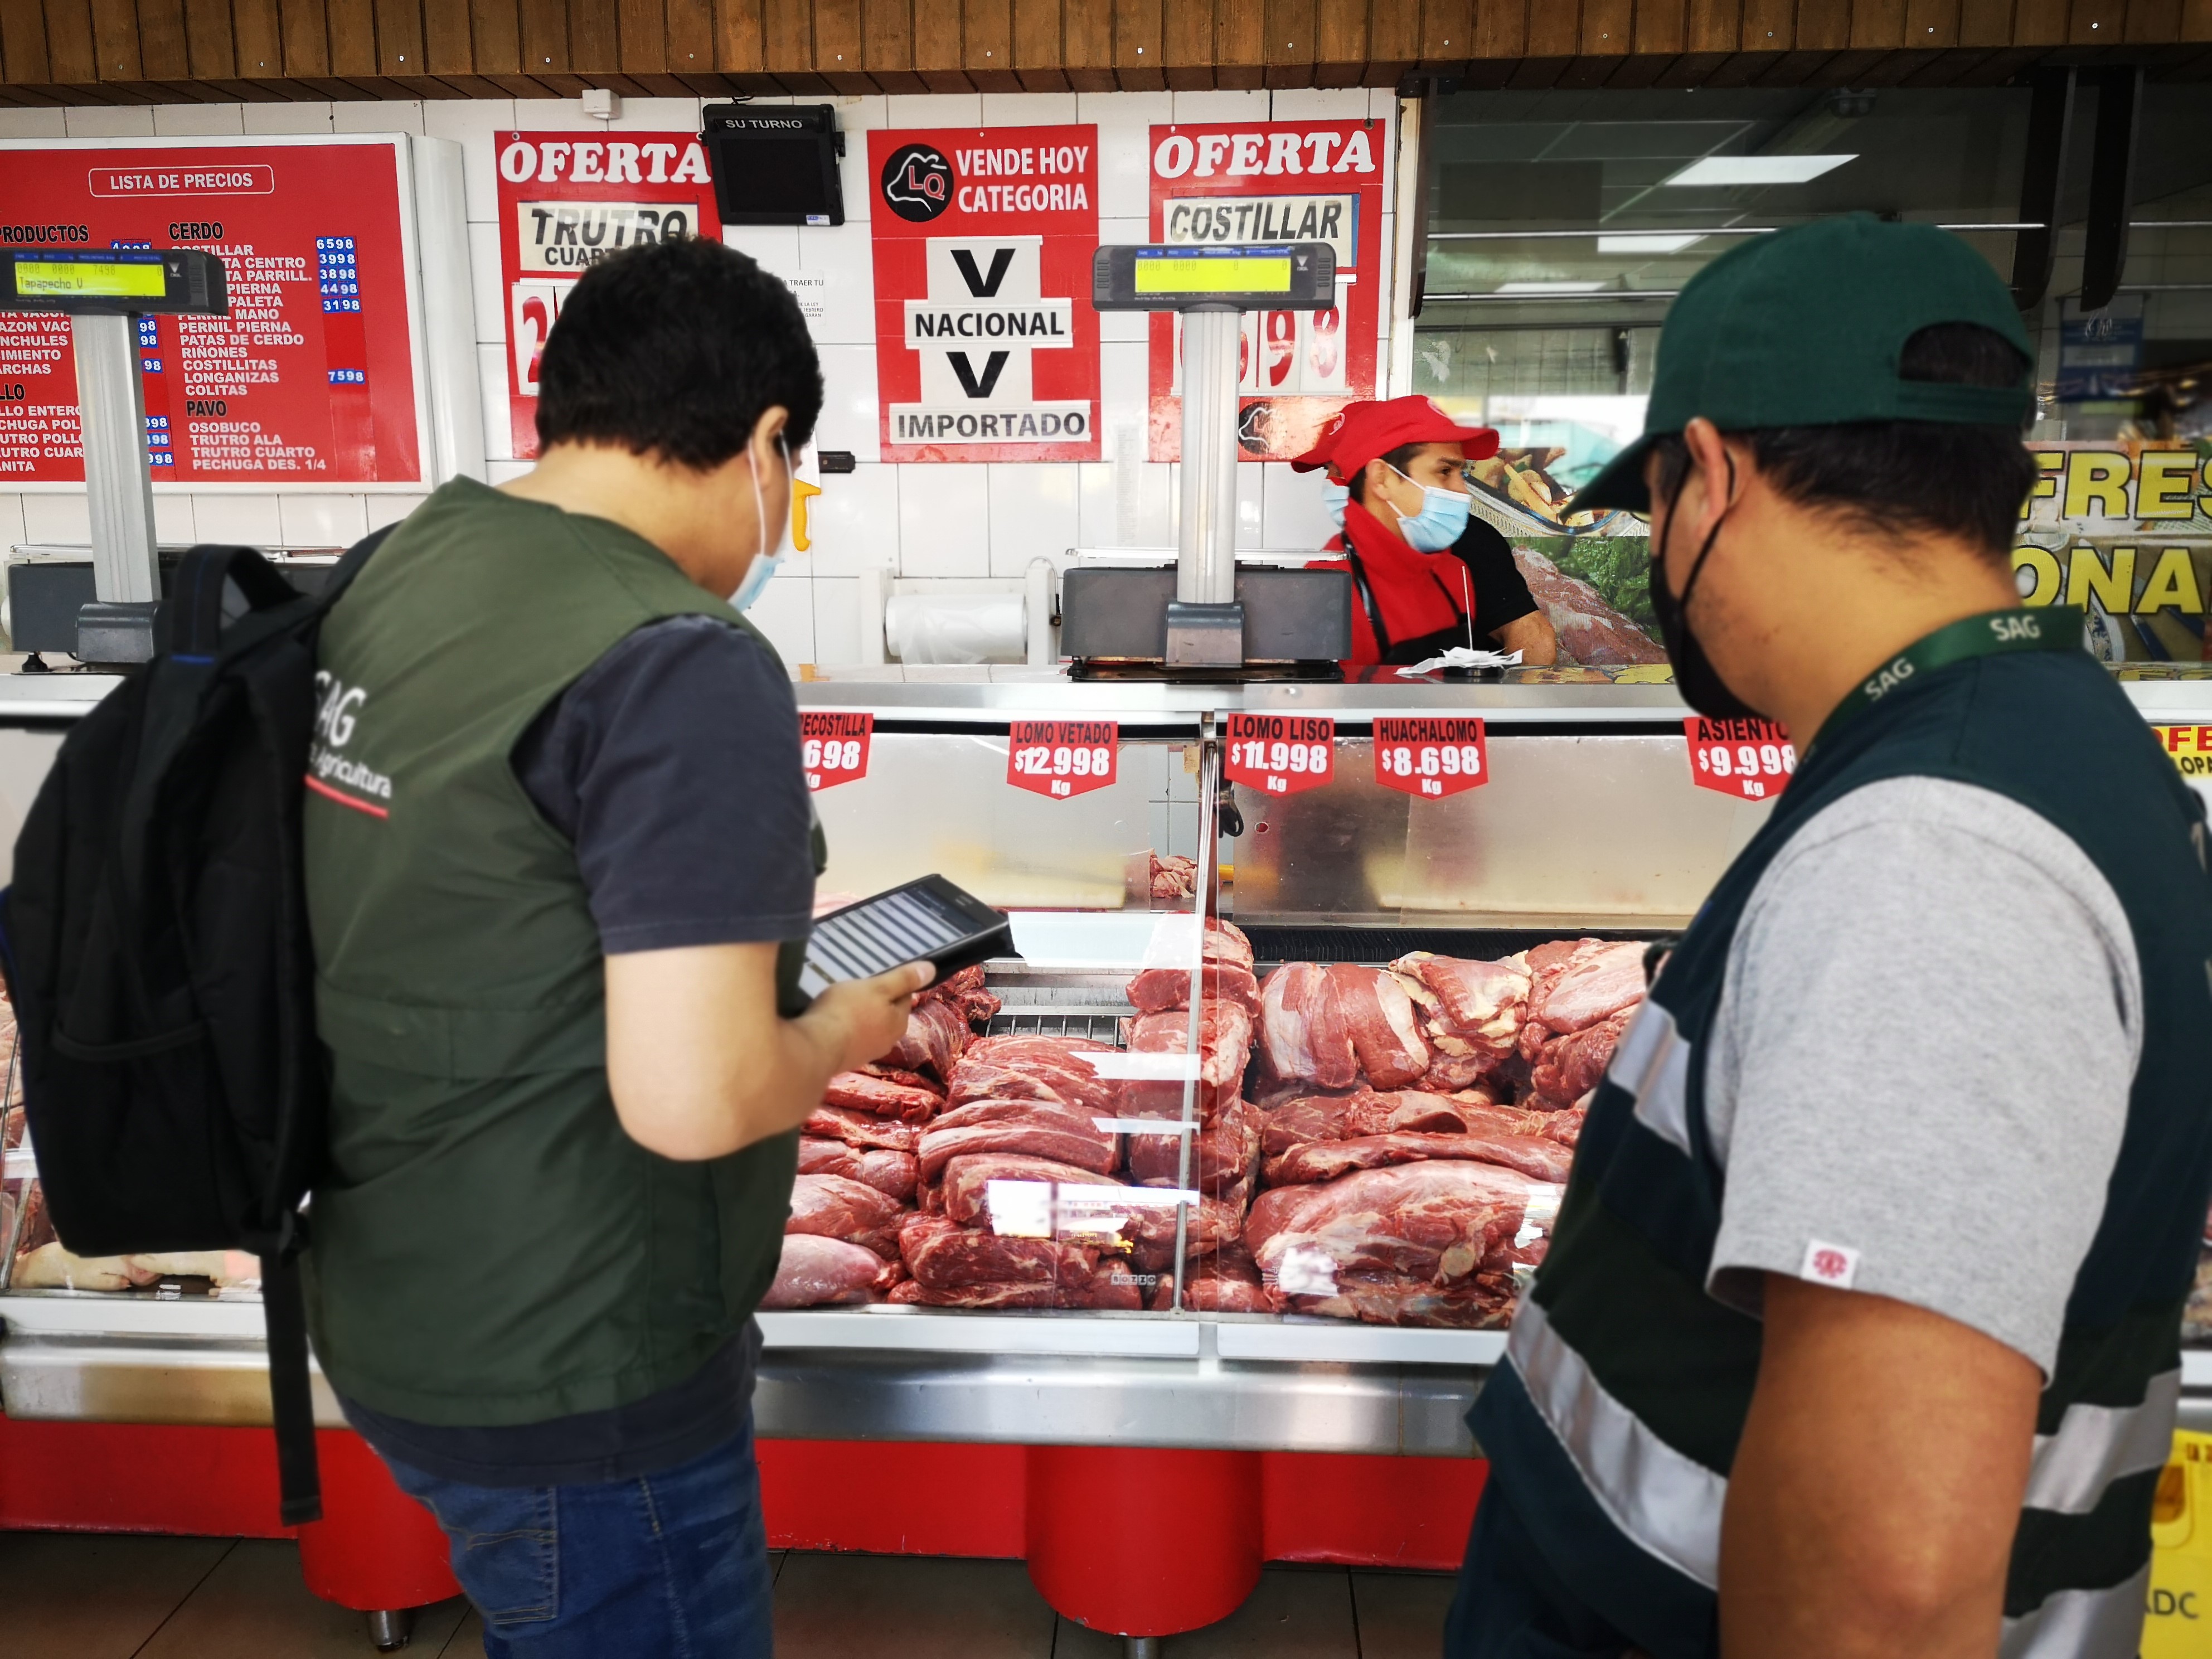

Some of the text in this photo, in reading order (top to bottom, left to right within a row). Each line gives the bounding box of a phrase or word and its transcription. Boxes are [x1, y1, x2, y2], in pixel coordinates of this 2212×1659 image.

[749, 120, 802, 129] TURNO
[955, 146, 1089, 176] VENDE HOY
[1154, 130, 1376, 179] OFERTA
[500, 142, 711, 184] OFERTA
[110, 173, 253, 190] LISTA DE PRECIOS
[909, 165, 945, 200] LQ
[958, 183, 1088, 213] CATEGORIA
[531, 208, 687, 246] TRUTRO
[1171, 200, 1342, 242] COSTILLAR
[168, 221, 224, 241] CERDO
[316, 239, 353, 250] 6598
[245, 257, 305, 269] CENTRO
[319, 254, 355, 264] 3998
[246, 270, 312, 282] PARRILL.
[319, 269, 356, 279] 3898
[950, 248, 1016, 297] V
[19, 277, 83, 291] Tapapecho V
[226, 283, 282, 294] PIERNA
[321, 282, 358, 294] 4498
[228, 296, 283, 307] PALETA
[323, 299, 360, 311] 3198
[235, 308, 279, 320] MANO
[41, 321, 70, 332] VAC
[179, 321, 292, 333] PERNIL PIERNA
[915, 312, 1065, 337] NACIONAL
[180, 333, 304, 346] PATAS DE CERDO
[0, 350, 61, 360] IMIENTO
[182, 345, 248, 358] RIÑONES
[183, 359, 278, 371] COSTILLITAS
[185, 372, 279, 384] LONGANIZAS
[328, 370, 364, 382] 7598
[945, 351, 1010, 398] V
[186, 385, 248, 396] COLITAS
[186, 400, 227, 417] PAVO
[189, 421, 261, 433] OSOBUCO
[898, 413, 1085, 438] IMPORTADO
[0, 433, 38, 444] UTRO
[190, 434, 283, 446] TRUTRO ALA
[0, 447, 84, 458] UTRO CUAR
[191, 447, 315, 458] TRUTRO CUARTO
[0, 461, 35, 471] NITA
[193, 459, 326, 470] PECHUGA DES. 1/4
[1990, 615, 2041, 641] SAG
[1865, 657, 1915, 702] SAG
[1016, 723, 1112, 744] LOMO VETADO
[1232, 716, 1331, 741] LOMO LISO
[1380, 719, 1477, 743] HUACHALOMO
[1231, 741, 1328, 774] $11.998
[1382, 745, 1481, 776] $8.698
[1698, 744, 1796, 777] $9.998
[1051, 779, 1070, 796] Kg
[1267, 775, 1287, 793] Kg
[1422, 778, 1442, 795] Kg
[1742, 779, 1764, 797] Kg
